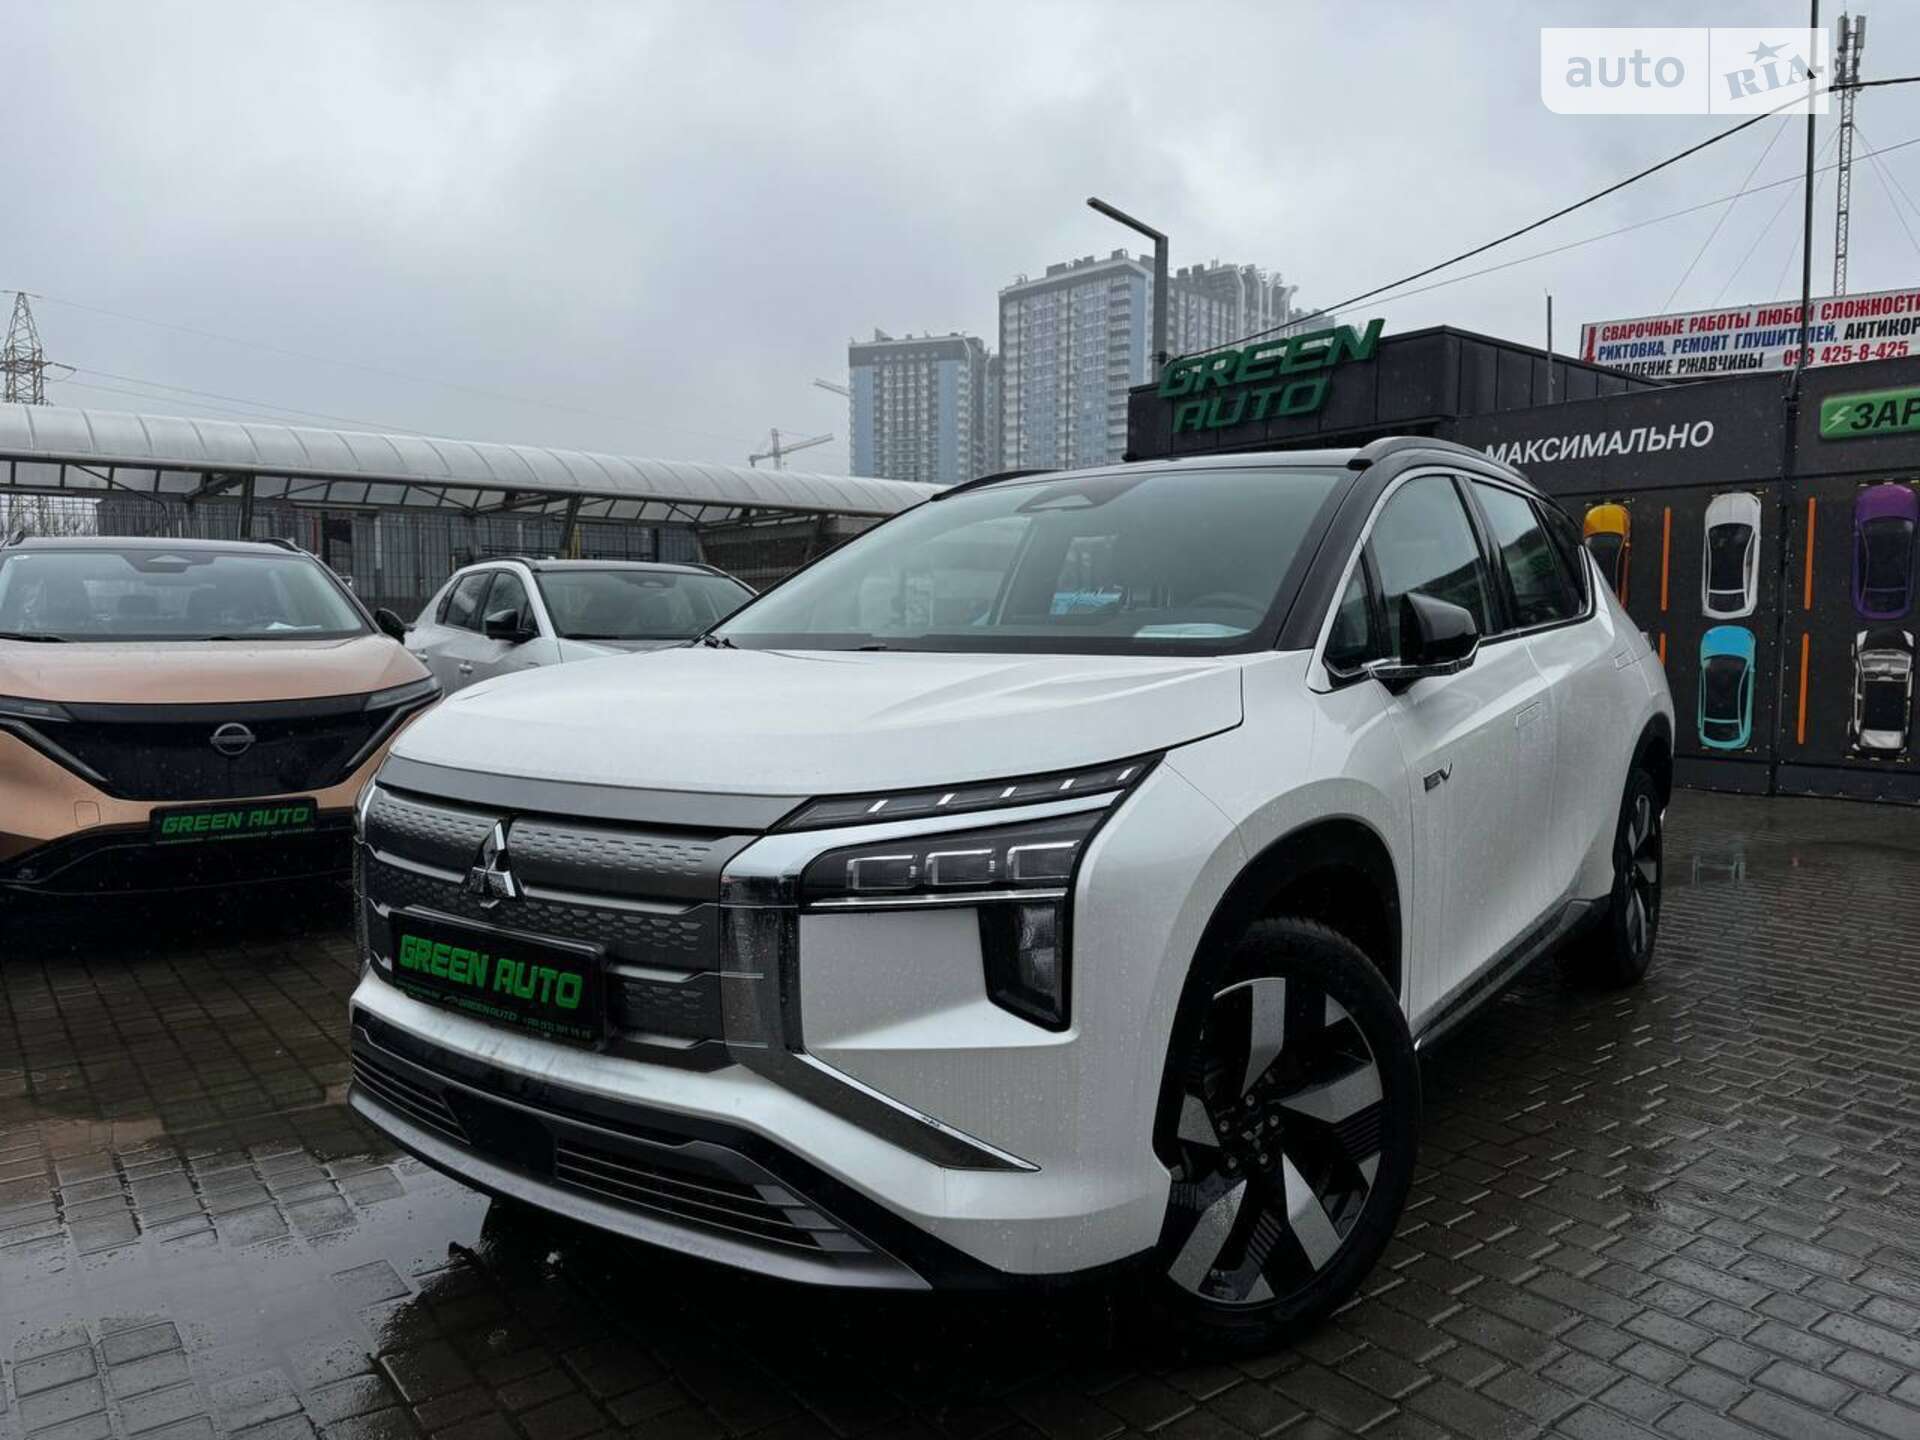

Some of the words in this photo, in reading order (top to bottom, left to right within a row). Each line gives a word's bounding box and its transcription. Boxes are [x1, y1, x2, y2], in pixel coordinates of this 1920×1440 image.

[1602, 318, 1684, 342] СВАРОЧНЫЕ
[1689, 311, 1750, 334] РАБОТЫ
[1672, 334, 1730, 355] РЕМОНТ
[1157, 318, 1385, 398] GREEN
[1677, 351, 1763, 375] РЖАВЧИНЫ
[1821, 340, 1909, 364] 425-8-425
[1173, 377, 1330, 433] AUTO
[1485, 420, 1714, 466] МАКСИМАЛЬНО
[161, 811, 244, 834] GREEN
[248, 807, 310, 827] AUTO
[400, 934, 490, 988] GREEN
[493, 958, 583, 1009] AUTO
